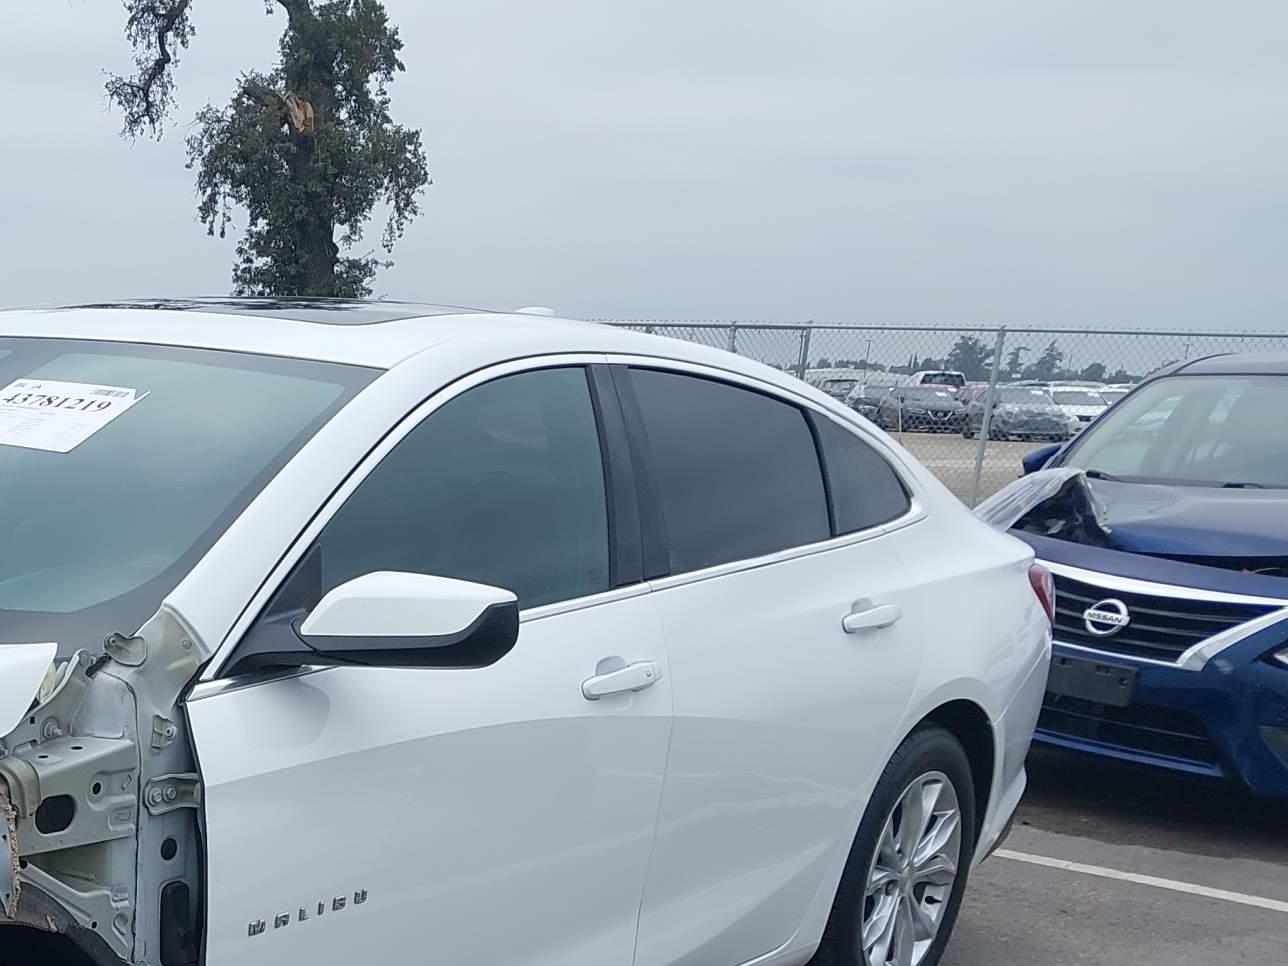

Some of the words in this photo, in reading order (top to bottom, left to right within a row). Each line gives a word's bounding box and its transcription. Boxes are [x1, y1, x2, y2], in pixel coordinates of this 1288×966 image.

[2, 392, 112, 413] 43781219
[1087, 611, 1123, 624] NISSAN
[247, 888, 368, 937] MALIBU
